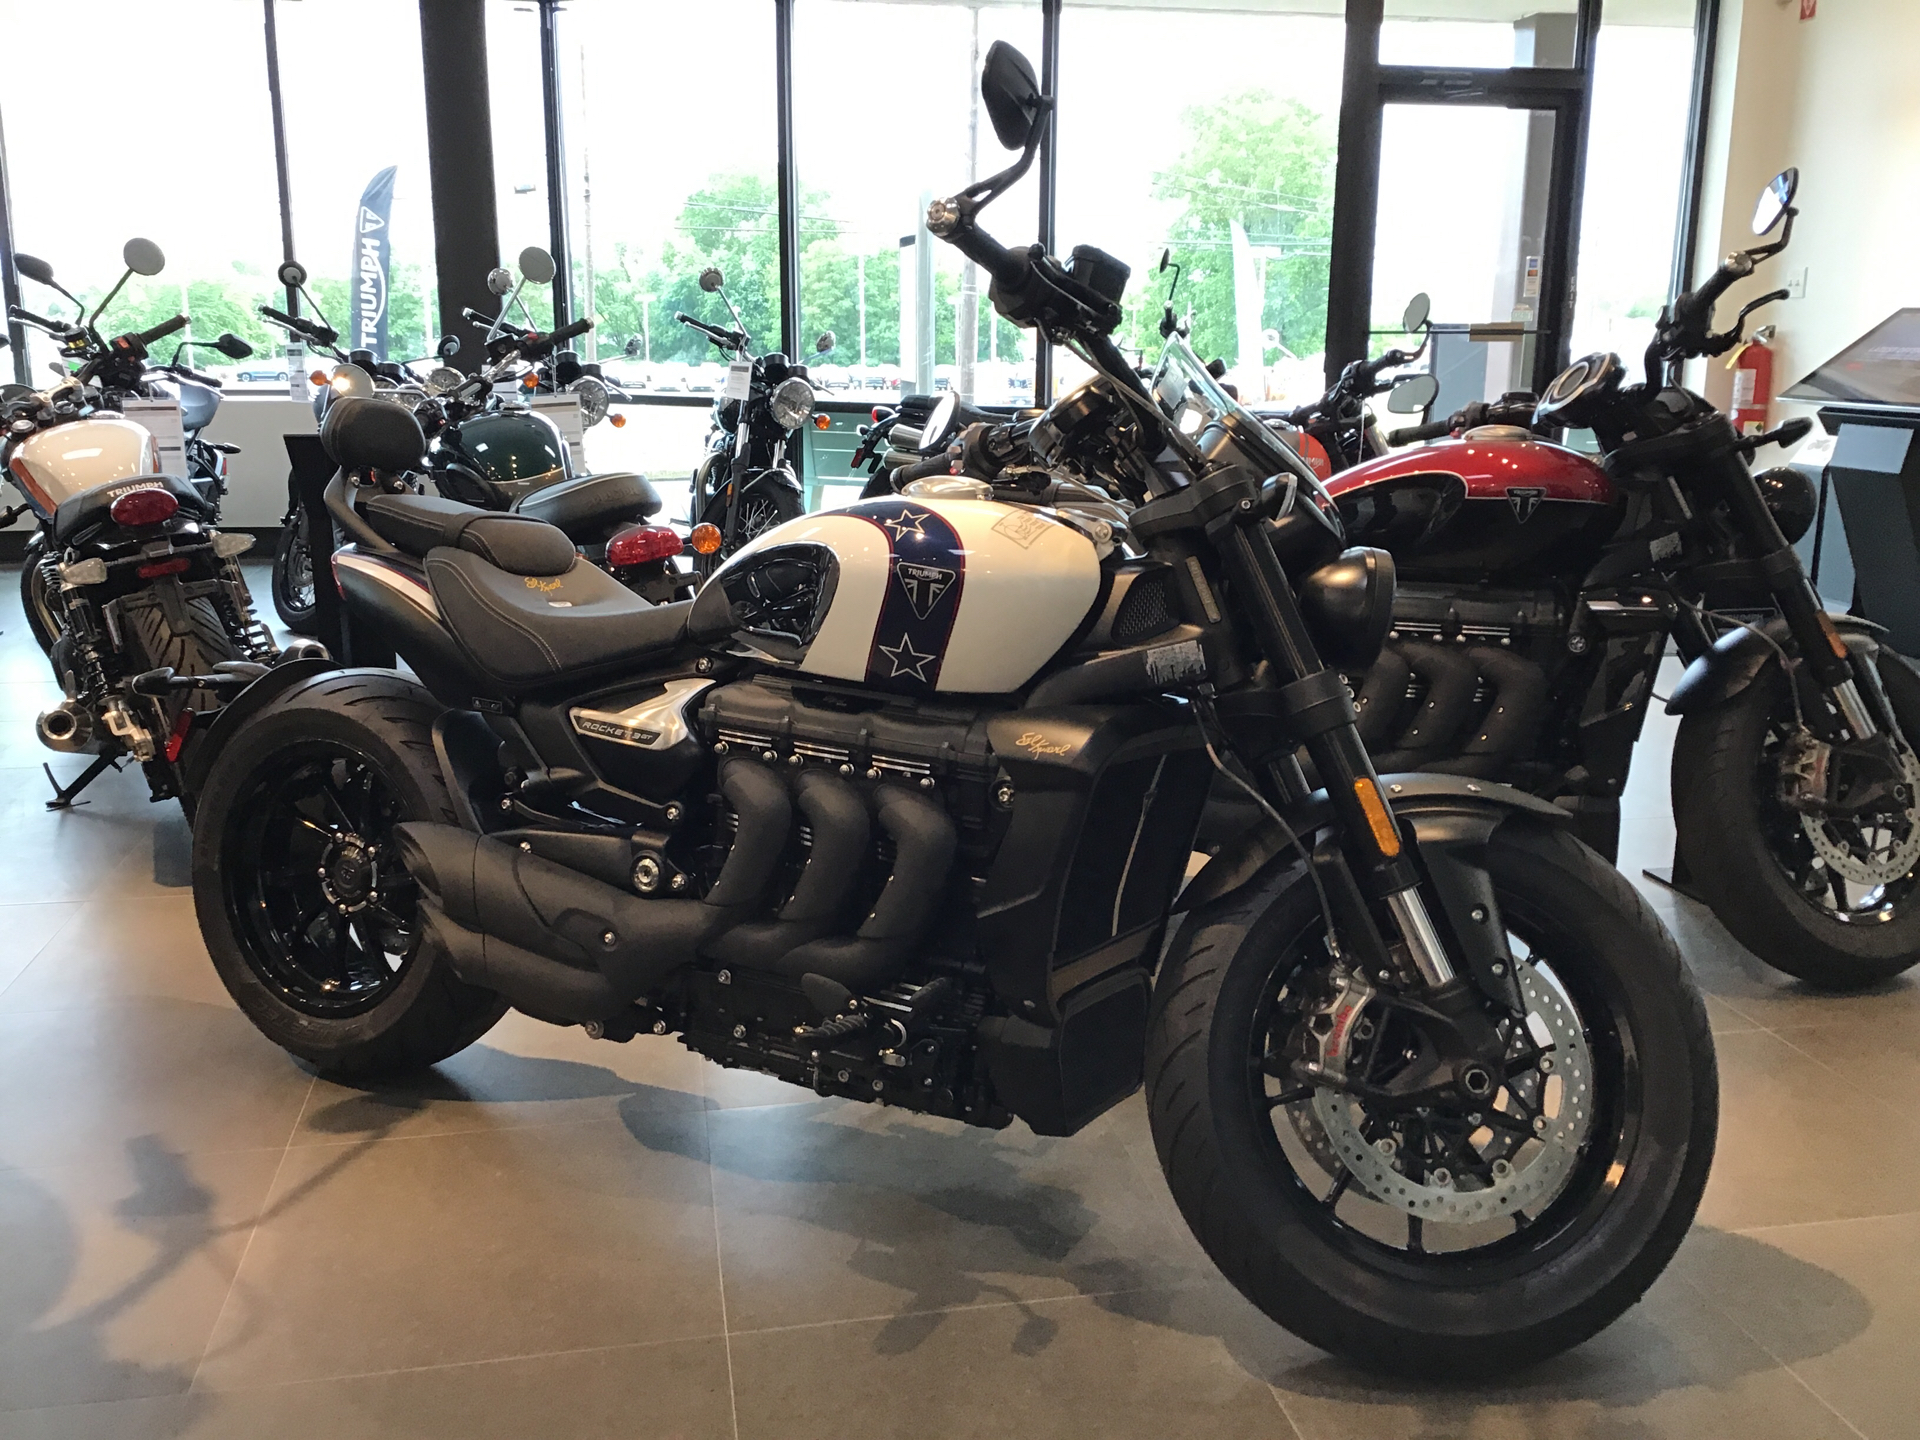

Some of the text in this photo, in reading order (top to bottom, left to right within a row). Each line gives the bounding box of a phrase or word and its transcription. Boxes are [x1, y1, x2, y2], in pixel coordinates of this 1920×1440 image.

[360, 237, 386, 349] TRIUMPH
[1568, 276, 1576, 310] EXIT
[106, 481, 165, 498] TRIUMPH
[907, 567, 943, 581] TRIUMPH
[582, 721, 632, 738] ROCKET
